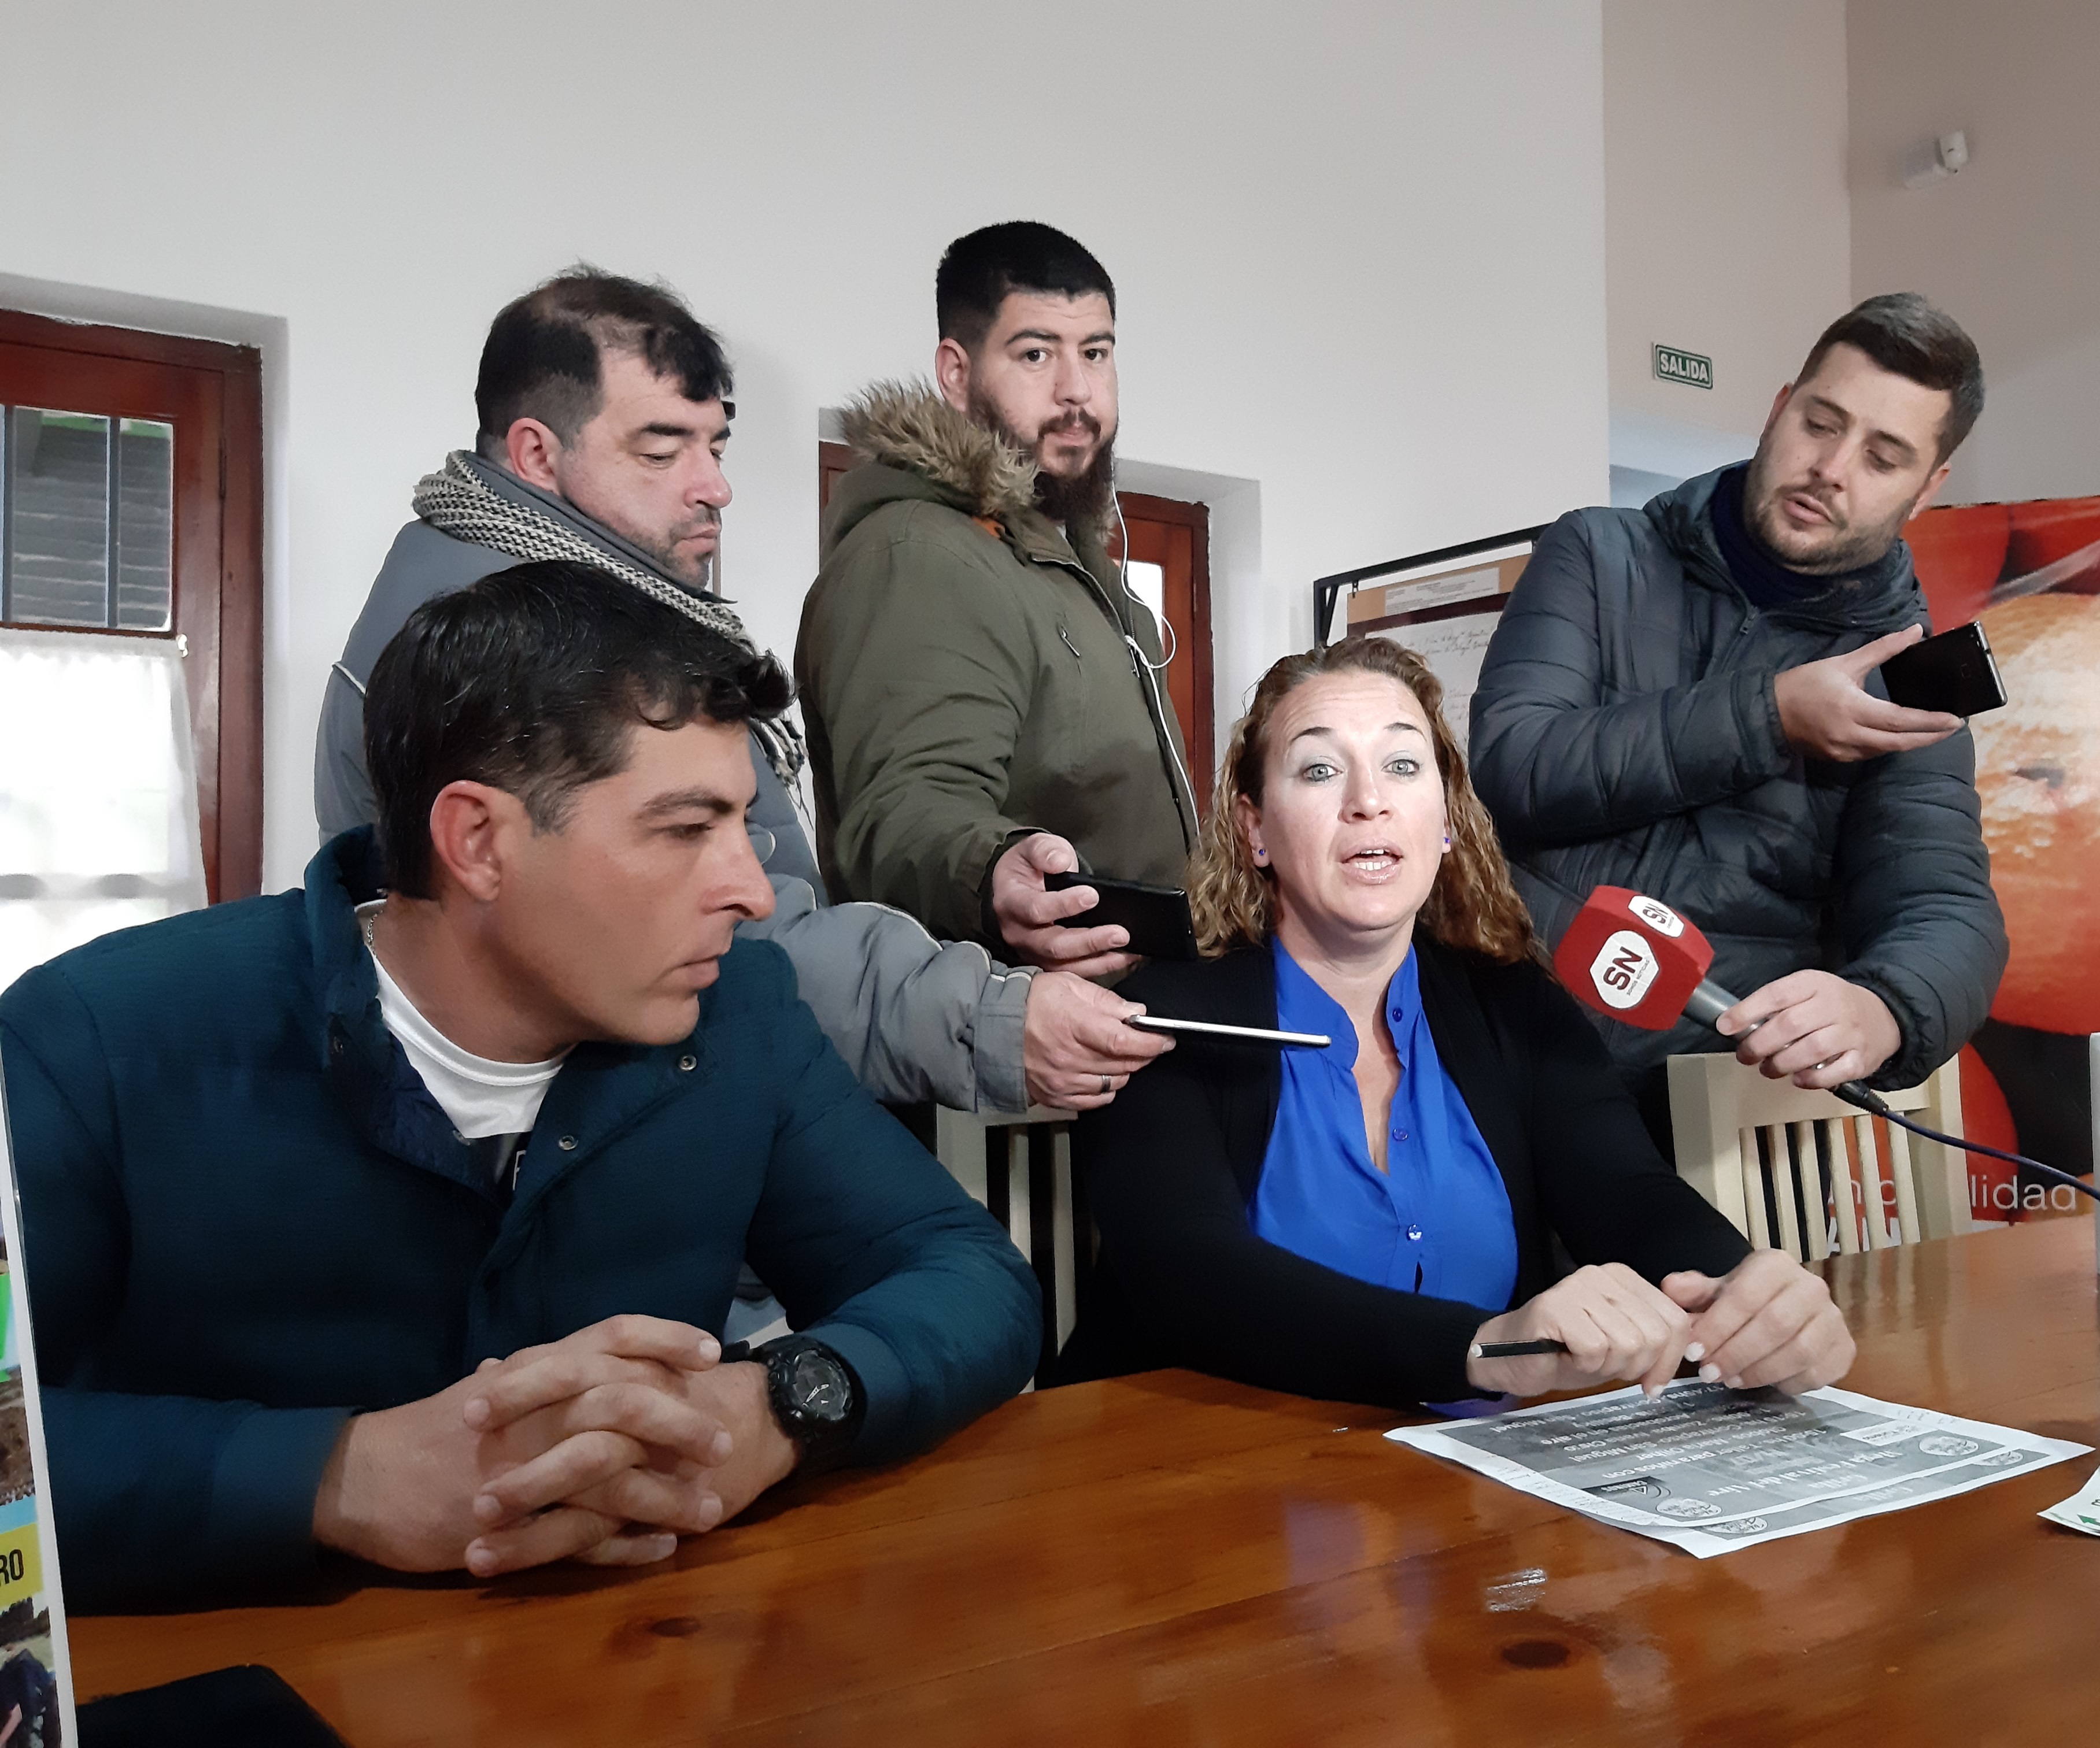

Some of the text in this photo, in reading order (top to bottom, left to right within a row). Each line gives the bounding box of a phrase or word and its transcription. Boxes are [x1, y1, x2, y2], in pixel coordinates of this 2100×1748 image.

[1660, 353, 1708, 382] SALIDA
[1643, 903, 1668, 924] SN
[1603, 946, 1643, 990] SN
[1678, 1451, 1717, 1462] para
[1602, 1469, 1635, 1478] con
